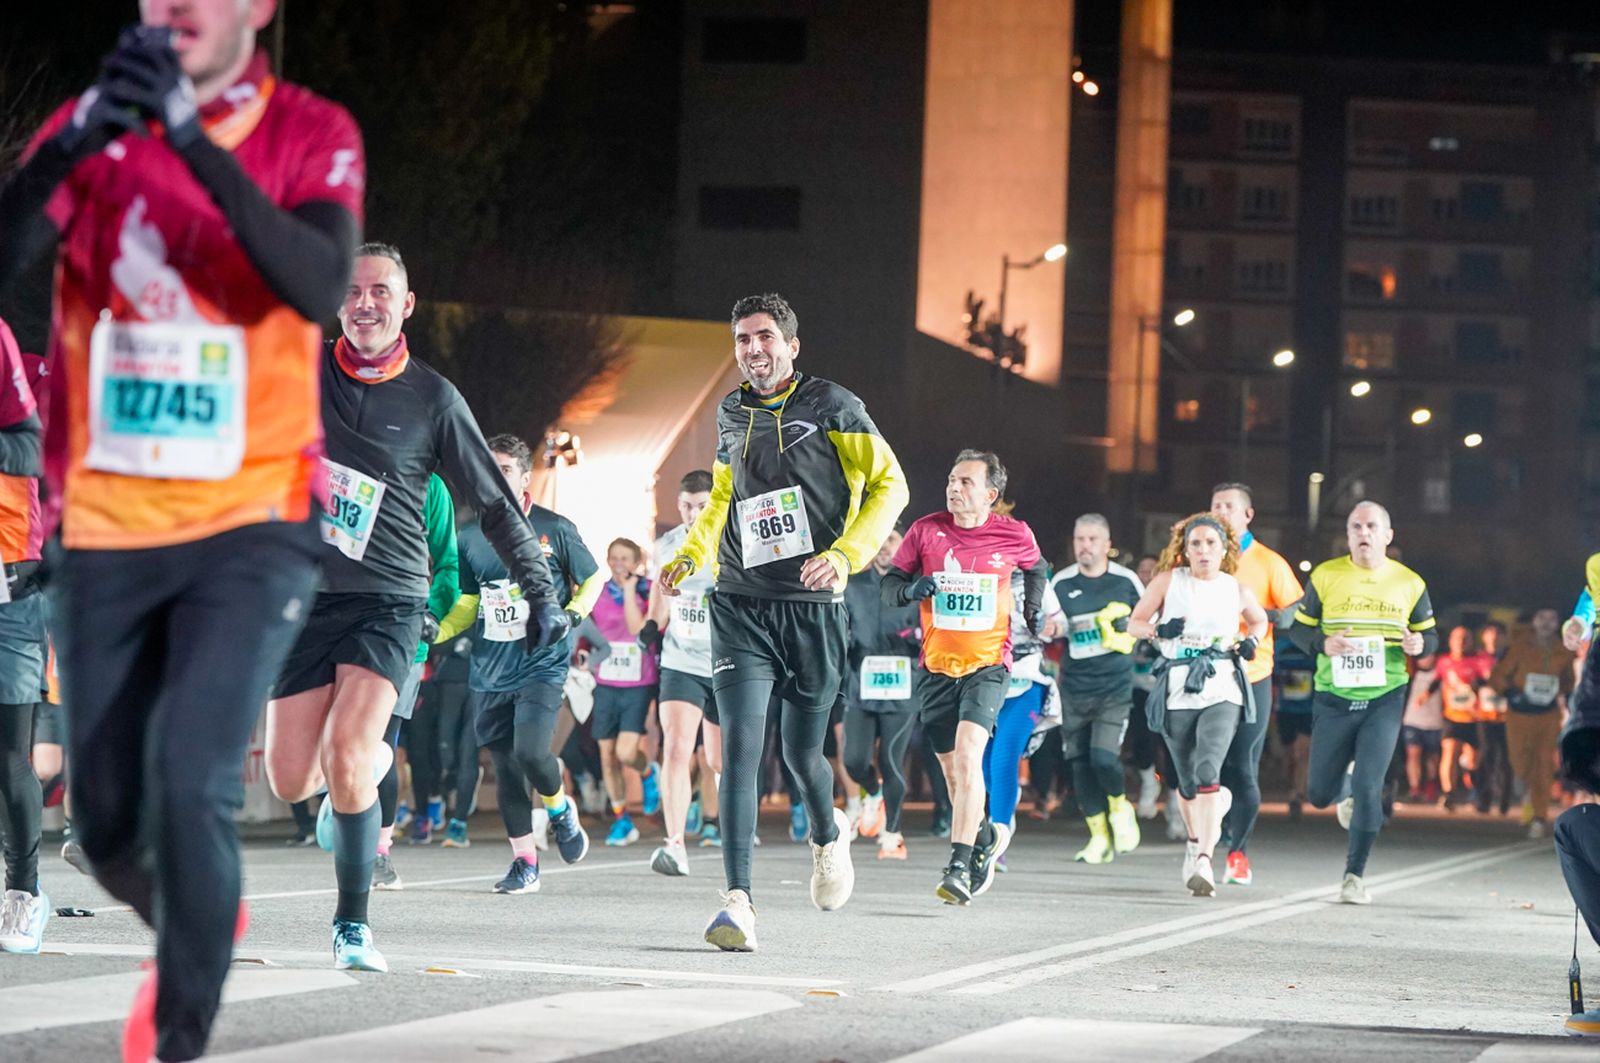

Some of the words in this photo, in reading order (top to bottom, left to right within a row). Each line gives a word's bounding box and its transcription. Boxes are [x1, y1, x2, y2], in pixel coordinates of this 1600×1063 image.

[115, 378, 216, 423] 12745
[329, 494, 362, 529] 913
[946, 593, 982, 611] 8121
[494, 605, 519, 624] 622
[678, 608, 706, 624] 1966
[1340, 655, 1374, 670] 7596
[872, 672, 900, 685] 7361
